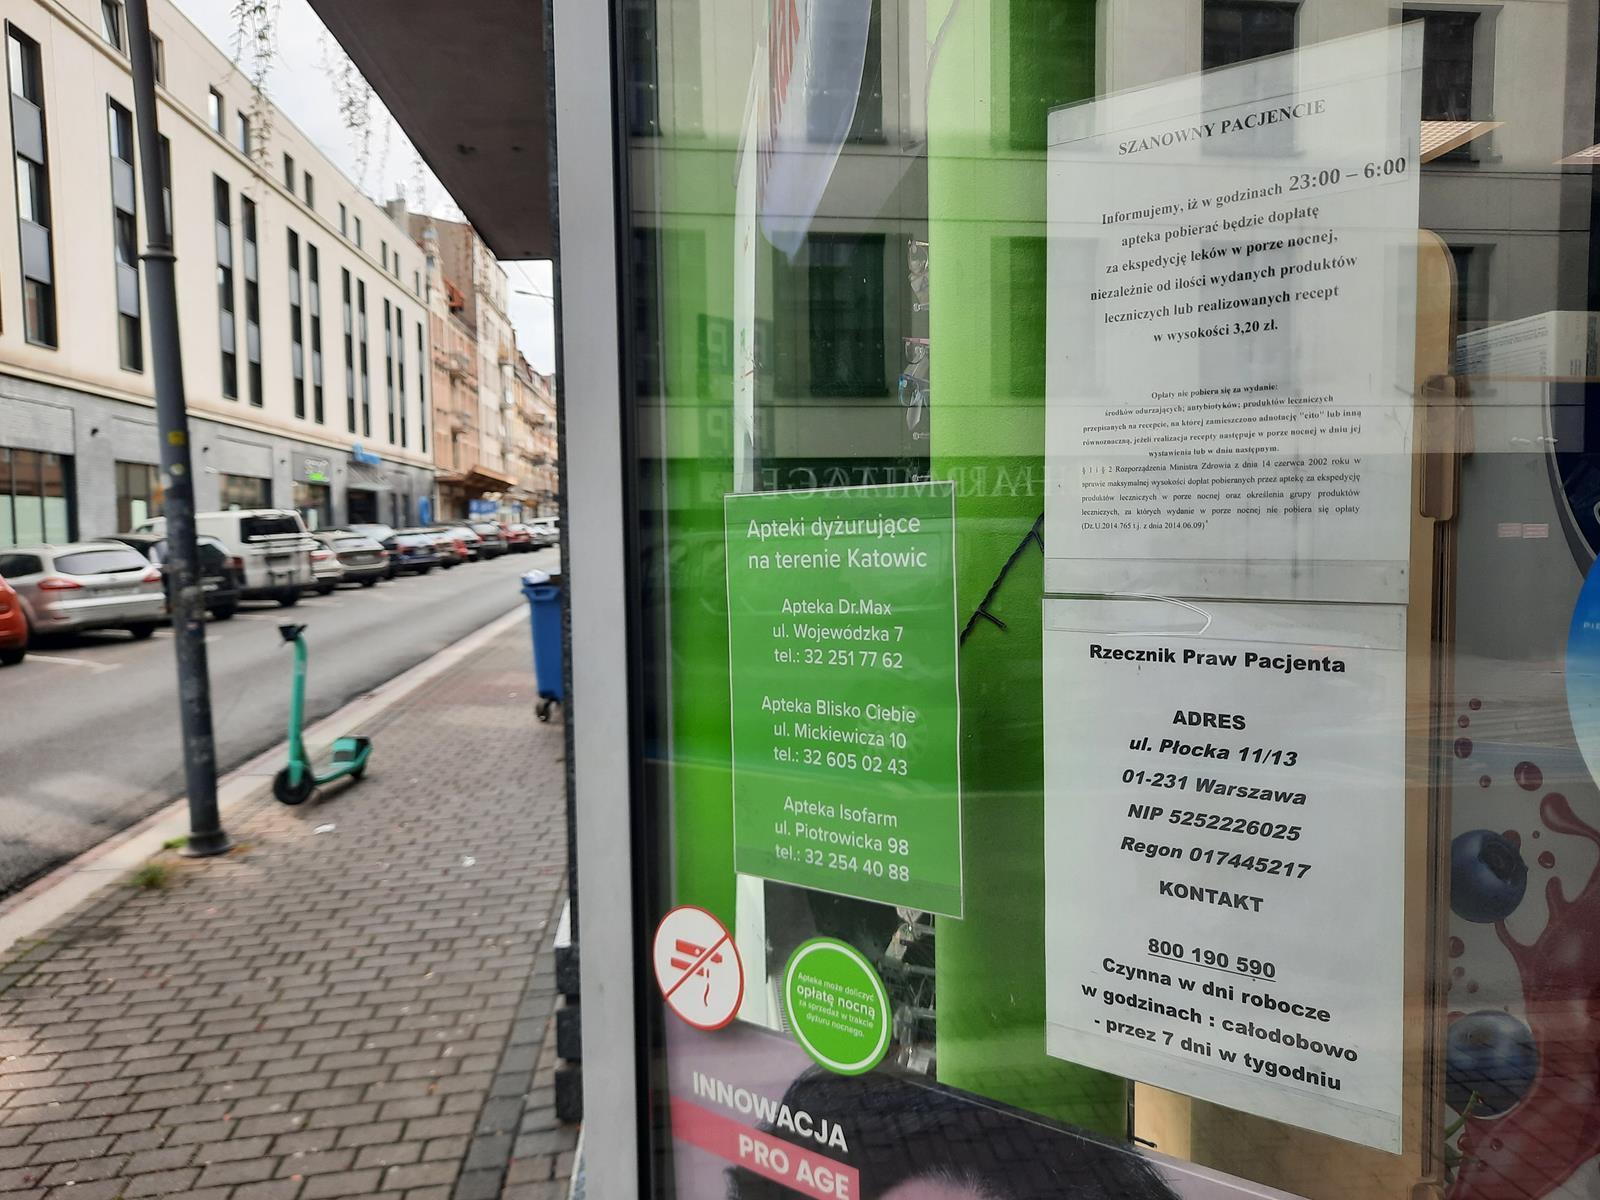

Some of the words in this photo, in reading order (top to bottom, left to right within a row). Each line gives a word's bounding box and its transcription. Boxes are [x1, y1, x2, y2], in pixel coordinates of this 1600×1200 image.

[1119, 123, 1215, 155] SZANOWNY
[1222, 99, 1325, 134] PACJENCIE
[1102, 204, 1184, 225] Informujemy,
[1188, 198, 1198, 210] iż
[1202, 199, 1212, 207] w
[1216, 183, 1282, 208] godzinach
[1289, 168, 1340, 191] 23:00
[1364, 157, 1406, 179] 6:00
[1122, 232, 1160, 248] apteka
[1165, 221, 1218, 243] pobierać
[1223, 214, 1264, 232] będzie
[1268, 207, 1319, 224] dopłatę
[1106, 265, 1118, 274] za
[1122, 253, 1186, 272] ekspedycję
[1191, 247, 1227, 261] leków
[1231, 246, 1242, 255] w
[1246, 240, 1283, 257] porze
[1091, 283, 1153, 301] niezależnie
[1156, 280, 1171, 292] od
[1175, 274, 1206, 289] ilości
[1210, 266, 1275, 287] wydanych
[1280, 255, 1357, 279] produktów
[1105, 306, 1169, 323] leczniczych
[1174, 303, 1193, 315] lub
[1198, 291, 1290, 312] realizowanych
[1296, 286, 1338, 301] recept
[1154, 334, 1162, 342] w
[1167, 324, 1229, 343] wysokości
[1233, 320, 1260, 334] 3,20
[1264, 319, 1278, 331] zł.
[747, 518, 805, 542] Apteki
[811, 516, 920, 540] dyżurujące
[748, 555, 770, 569] na
[775, 548, 840, 569] terenie
[848, 547, 927, 568] Katowic
[782, 598, 834, 616] Apteka
[839, 599, 893, 615] Dr.Max
[773, 623, 789, 638] ul.
[793, 624, 889, 642] Wojewódzka
[894, 626, 903, 642] 7
[774, 648, 800, 663] tel.:
[804, 648, 823, 664] 32
[828, 650, 854, 666] 251
[859, 651, 877, 667] 77
[882, 652, 903, 669] 62
[1090, 644, 1176, 663] Rzecznik
[1183, 649, 1237, 666] Praw
[1245, 652, 1345, 674] Pacjenta
[762, 696, 811, 714] Apteka
[816, 699, 861, 718] Blisko
[865, 704, 918, 723] Ciebie
[1172, 710, 1246, 730] ADRES
[774, 722, 790, 737] ul.
[794, 723, 884, 746] Mickiewicza
[890, 732, 907, 749] 10
[1129, 737, 1152, 751] ul.
[1159, 739, 1230, 760] Płocka
[1239, 747, 1298, 767] 11/13
[773, 746, 798, 762] tel.:
[804, 748, 822, 765] 32
[826, 751, 857, 769] 605
[862, 755, 882, 773] 02
[888, 758, 907, 776] 43
[1122, 769, 1188, 790] 01-231
[1196, 777, 1306, 805] Warszawa
[784, 796, 834, 818] Apteka
[840, 804, 897, 827] Isofarm
[1128, 804, 1164, 820] NIP
[1168, 809, 1302, 841] 5252226025
[775, 820, 790, 835] ul.
[796, 822, 882, 851] Piotrowicka
[888, 837, 909, 856] 98
[775, 844, 800, 861] tel.:
[805, 848, 823, 866] 32
[828, 853, 858, 872] 254
[862, 859, 883, 877] 40
[888, 864, 909, 882] 88
[1120, 836, 1183, 859] Regon
[1189, 847, 1312, 879] 017445217
[1160, 880, 1264, 912] KONTAKT
[1148, 938, 1184, 960] 800
[1192, 948, 1229, 968] 190
[1236, 956, 1276, 978] 590
[797, 985, 834, 1009] opłatę
[838, 998, 875, 1020] nocną
[1102, 958, 1171, 986] Czynna
[1178, 978, 1196, 991] w
[1202, 981, 1234, 1001] dni
[1242, 992, 1330, 1022] robocze
[1081, 984, 1097, 997] w
[1103, 990, 1202, 1024] godzinach
[1210, 1016, 1214, 1027] :
[1222, 1020, 1358, 1062] całodobowo
[1106, 1019, 1156, 1042] przez
[1162, 1031, 1174, 1045] 7
[1180, 1037, 1211, 1057] dni
[1218, 1049, 1237, 1063] w
[1244, 1053, 1340, 1091] tygodniu
[693, 1071, 848, 1153] INNOWACJA
[739, 1133, 789, 1174] PRO
[796, 1160, 850, 1200] AGE
